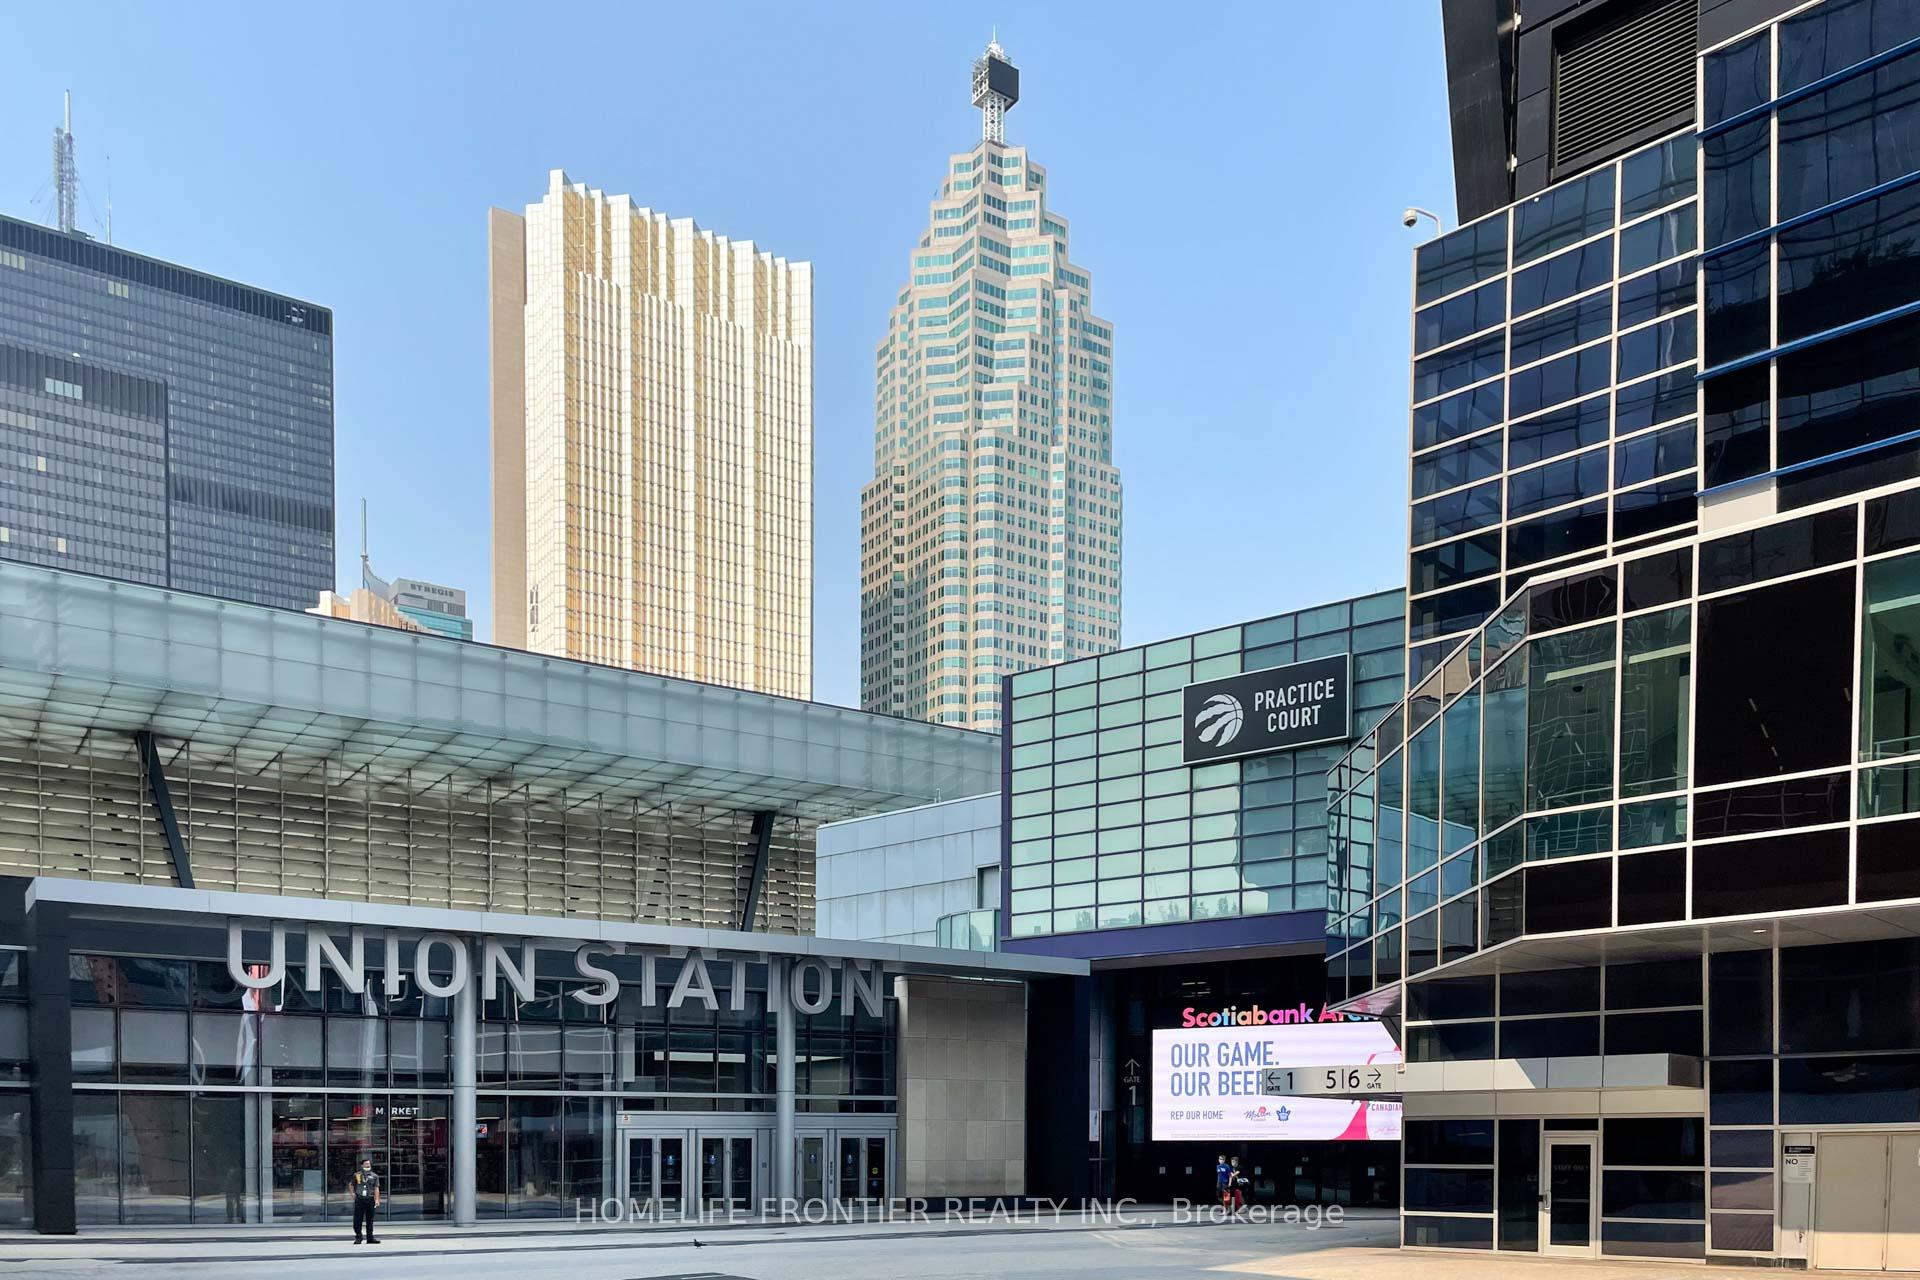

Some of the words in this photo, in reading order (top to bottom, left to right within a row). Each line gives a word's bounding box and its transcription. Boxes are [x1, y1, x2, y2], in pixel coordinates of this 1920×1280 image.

[1254, 678, 1335, 712] PRACTICE
[1267, 704, 1321, 733] COURT
[226, 915, 535, 1003] UNION
[571, 942, 884, 1018] STATION
[1182, 1003, 1314, 1028] Scotiabank
[1171, 1043, 1210, 1068] OUR
[1217, 1041, 1280, 1067] GAME.
[1171, 1071, 1211, 1097] OUR
[1286, 1071, 1294, 1090] 1
[1129, 1085, 1136, 1106] 1
[375, 1107, 420, 1115] MRKET
[1170, 1110, 1184, 1120] REP
[1186, 1110, 1200, 1120] OUR
[1202, 1110, 1224, 1120] HOME
